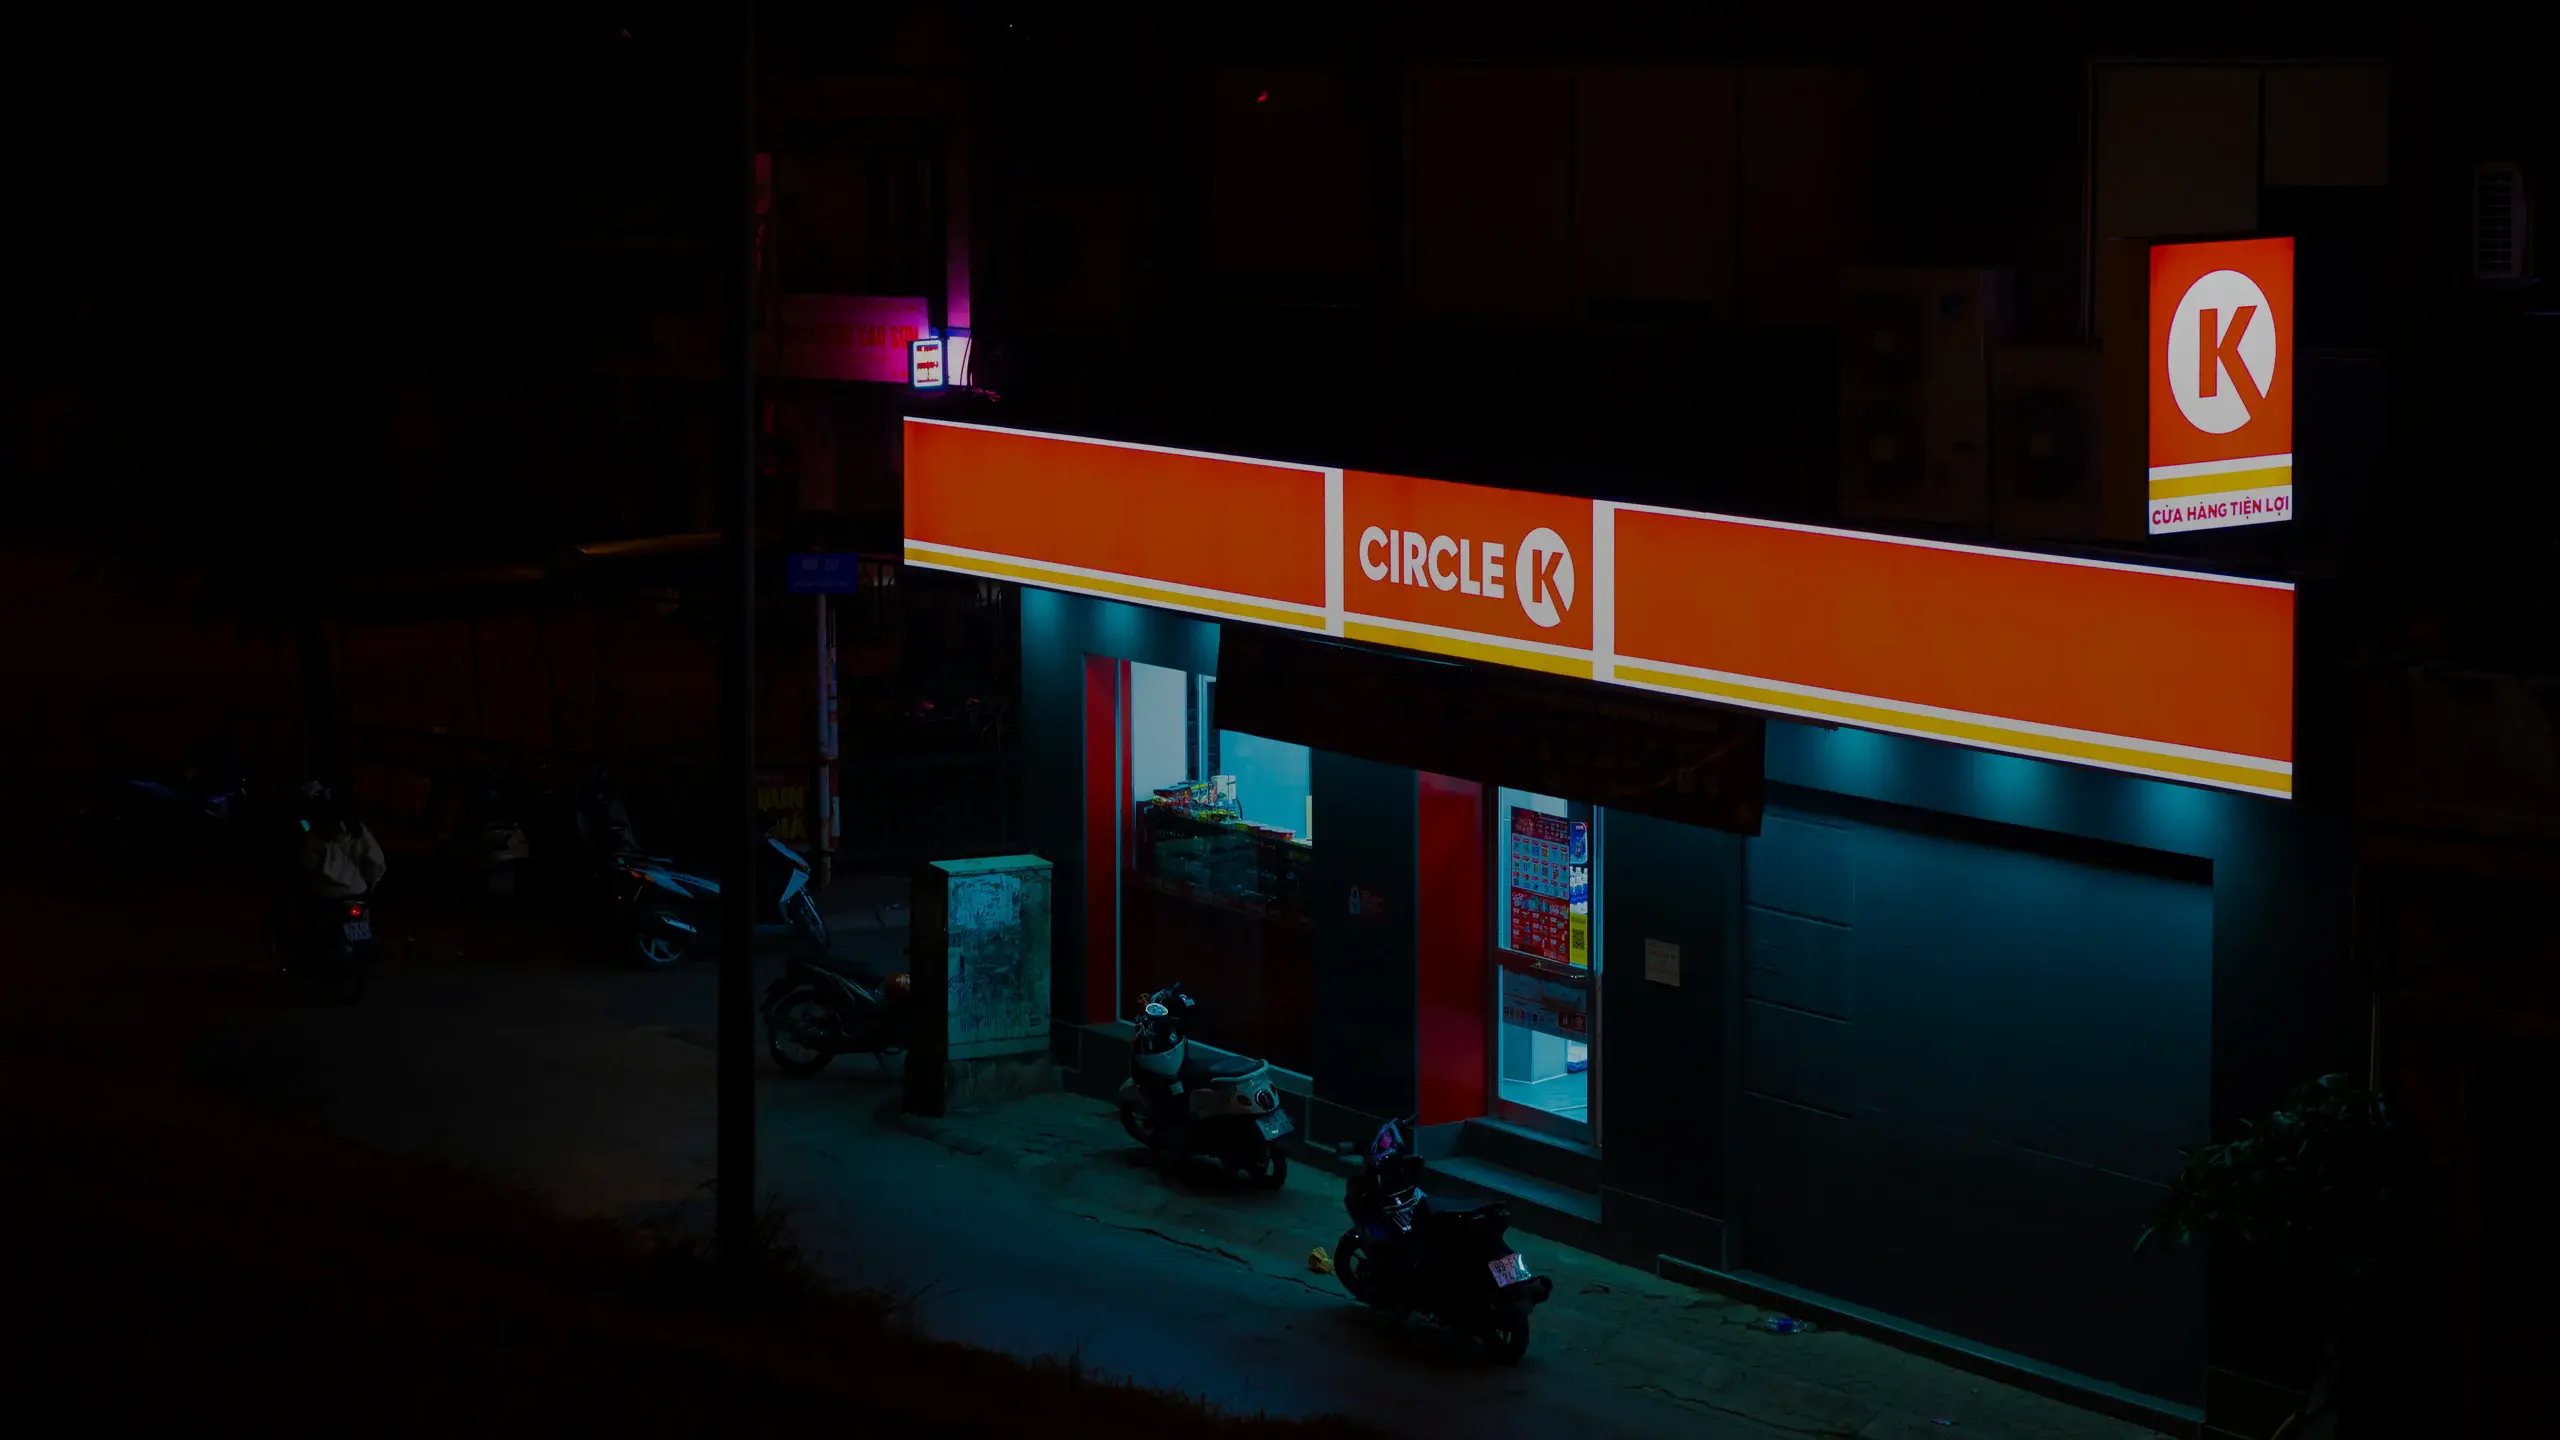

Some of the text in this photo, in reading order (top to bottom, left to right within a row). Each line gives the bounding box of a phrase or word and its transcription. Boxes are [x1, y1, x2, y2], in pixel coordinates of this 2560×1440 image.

[2194, 297, 2270, 424] K
[2152, 495, 2290, 525] CỬA HÀNG TIỆN LỢI
[1359, 525, 1505, 599] CIRCLE
